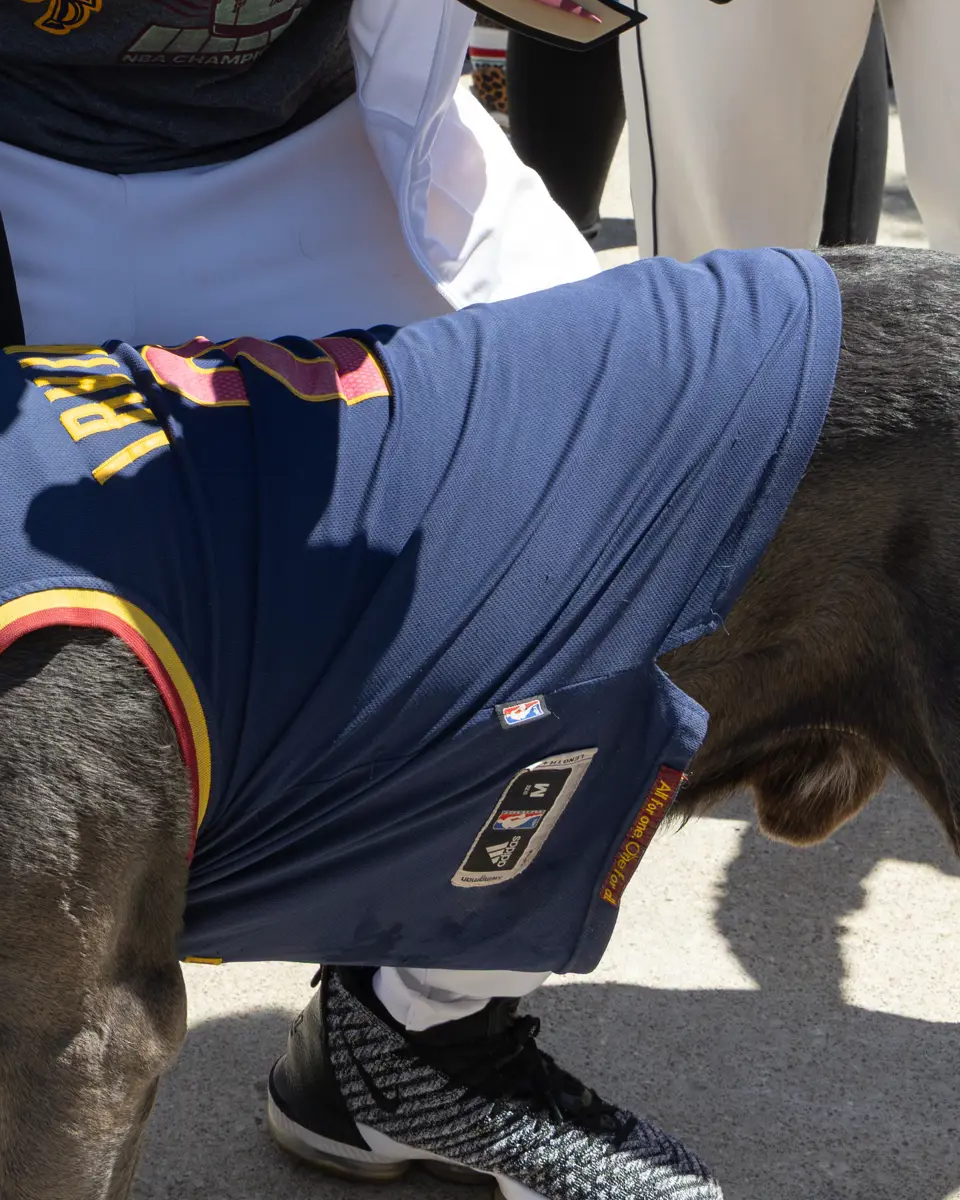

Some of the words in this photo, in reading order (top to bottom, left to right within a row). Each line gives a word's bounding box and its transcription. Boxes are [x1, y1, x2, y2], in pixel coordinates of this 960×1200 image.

[121, 54, 167, 64] NBA
[529, 783, 551, 798] M
[654, 780, 672, 800] All
[646, 797, 664, 816] for
[497, 835, 522, 868] adidas
[618, 841, 640, 869] One
[609, 867, 625, 889] for
